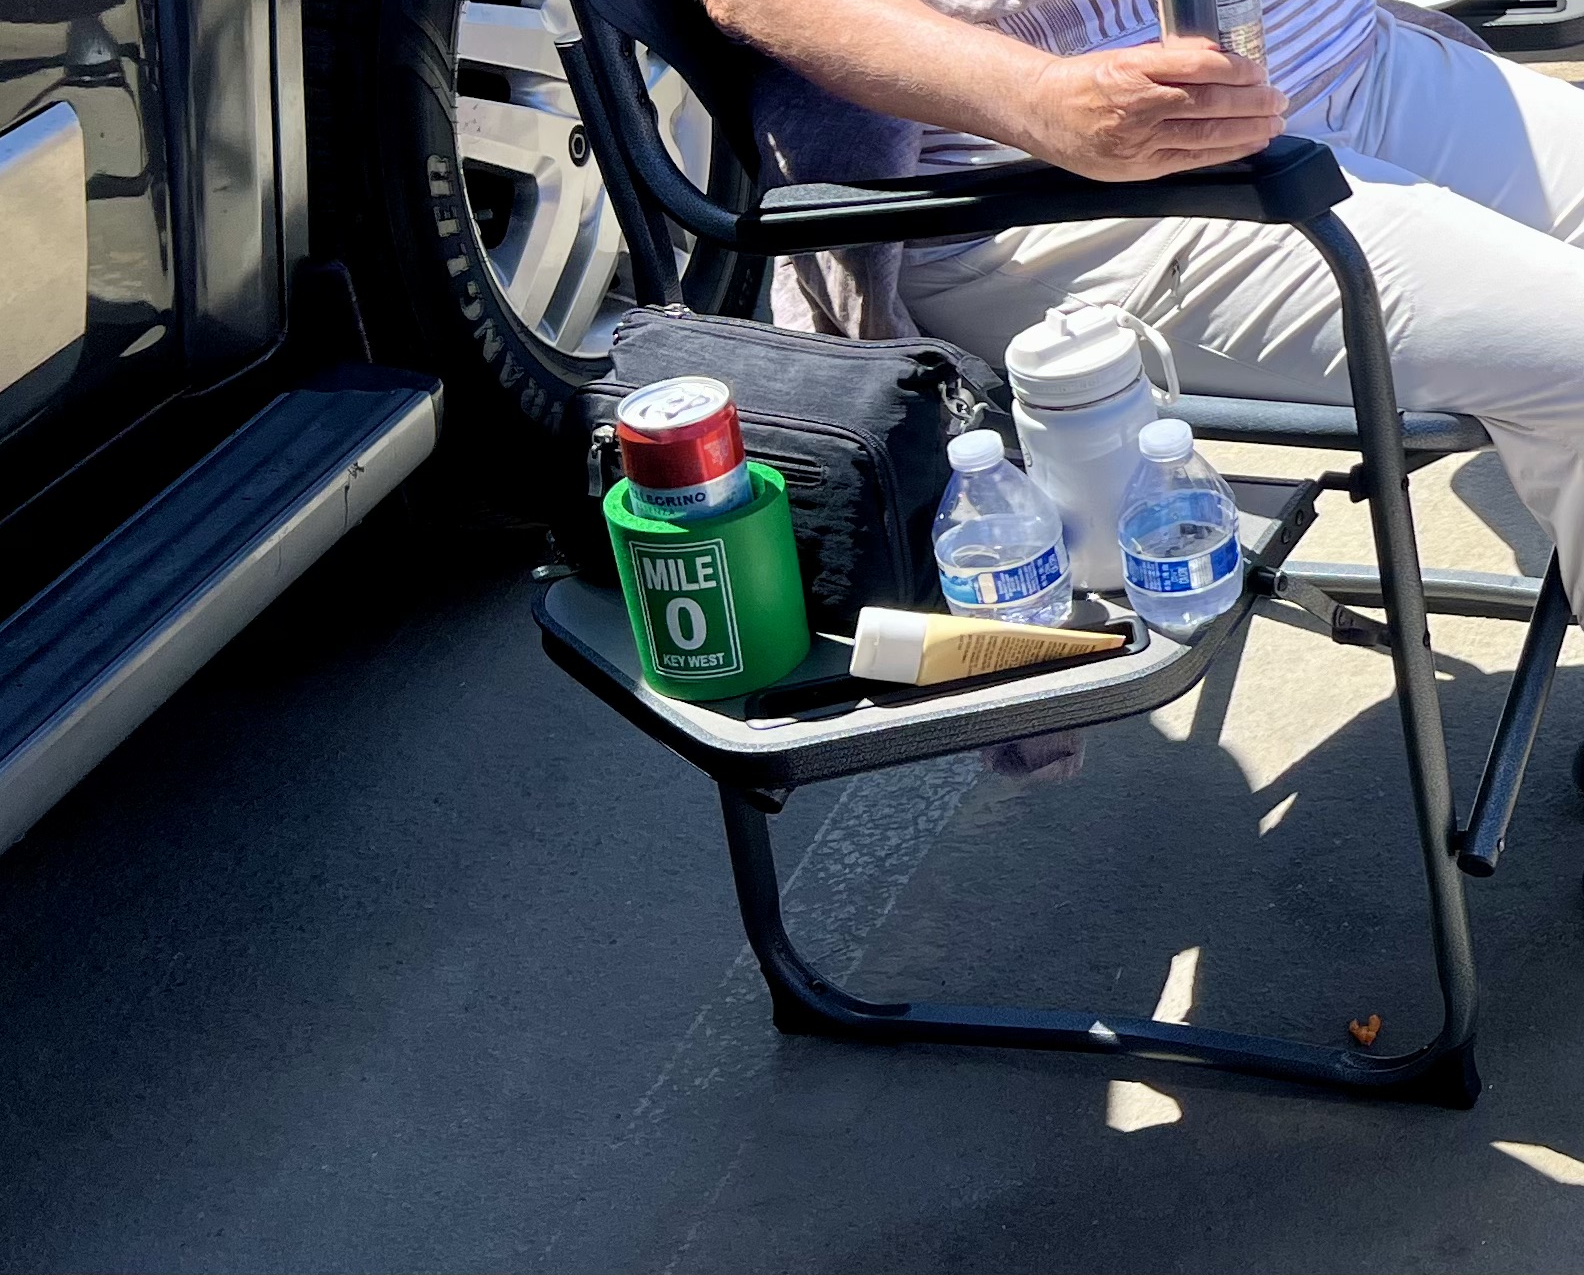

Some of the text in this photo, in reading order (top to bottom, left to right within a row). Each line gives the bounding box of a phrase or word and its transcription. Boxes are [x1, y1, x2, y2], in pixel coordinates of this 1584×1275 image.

[642, 555, 717, 592] MILE
[665, 597, 707, 651] 0
[663, 652, 725, 668] KEY WEST
